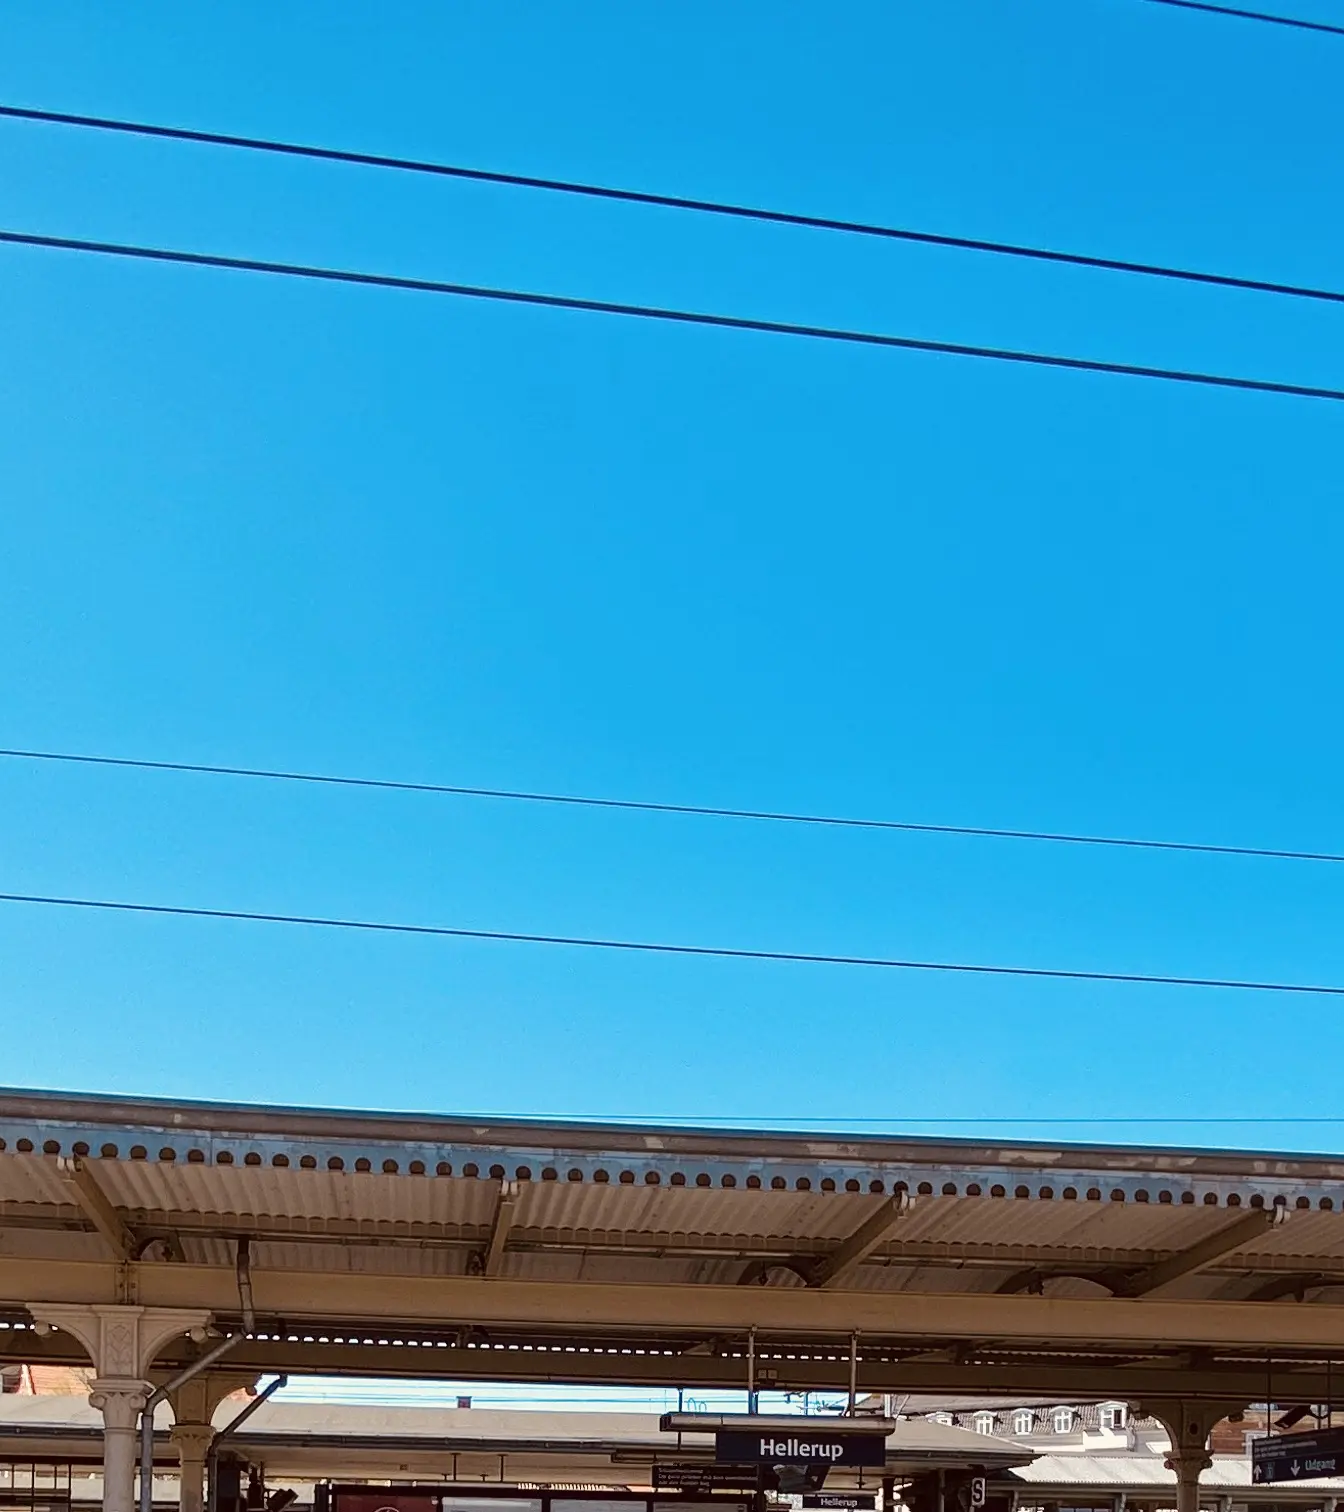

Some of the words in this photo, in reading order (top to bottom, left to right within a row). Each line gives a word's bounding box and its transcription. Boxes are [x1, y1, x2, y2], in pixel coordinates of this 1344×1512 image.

[759, 1438, 844, 1461] Hellerup
[820, 1497, 858, 1508] Hellerup
[972, 1479, 983, 1503] S
